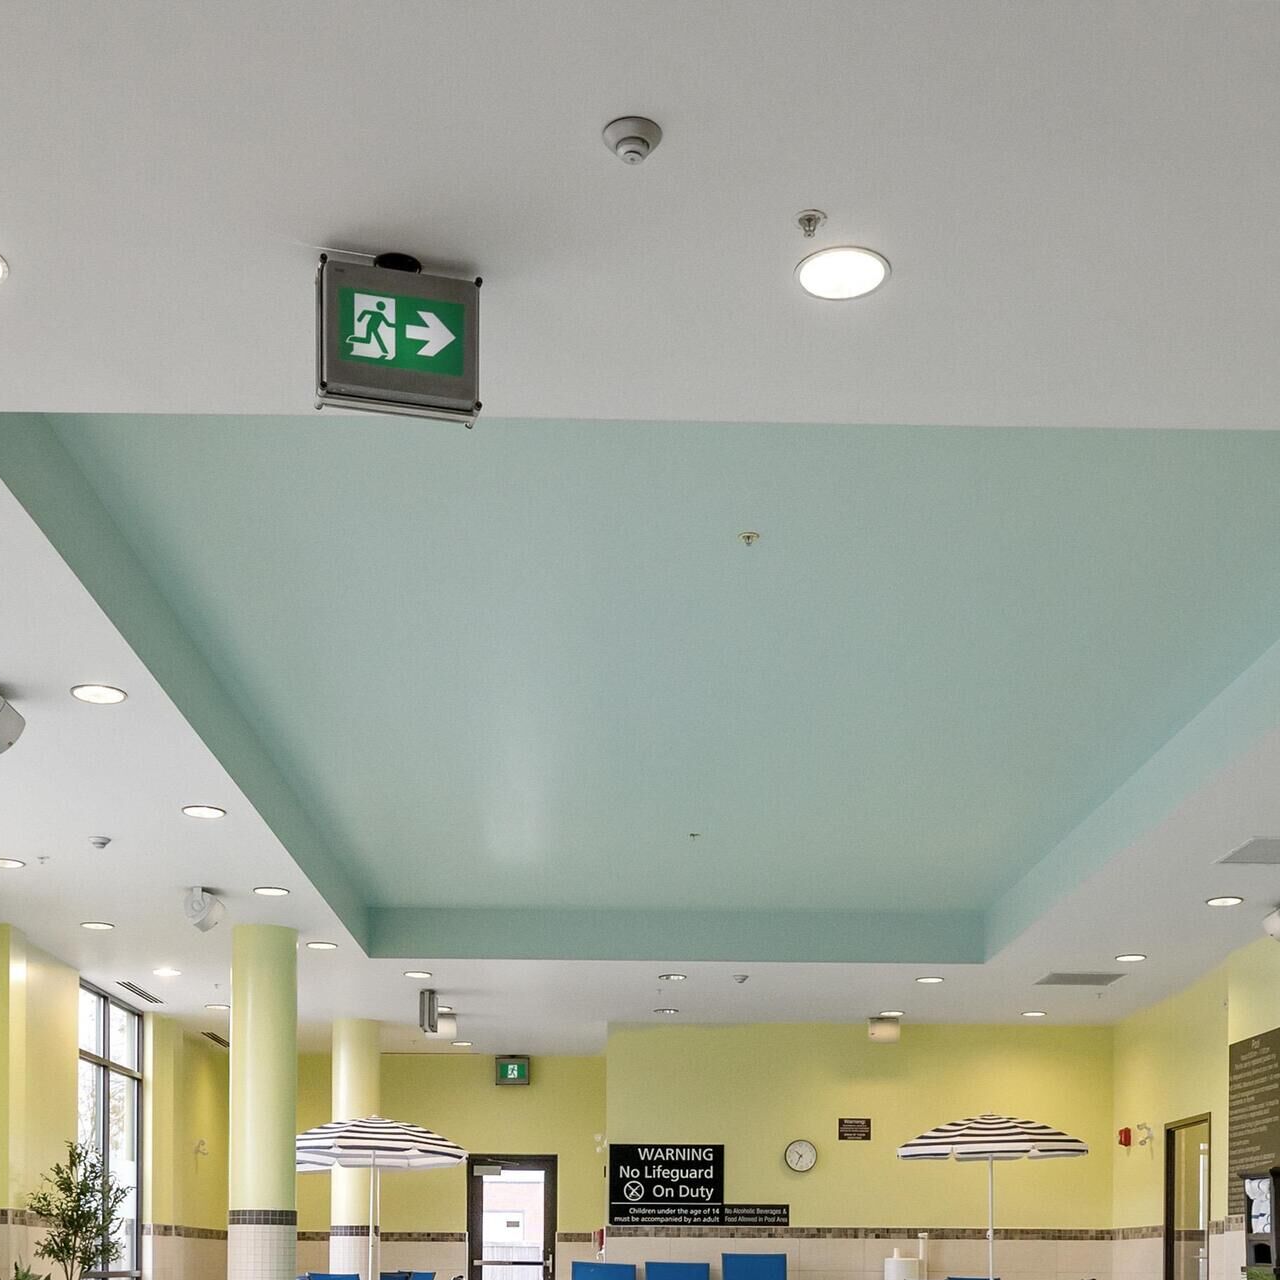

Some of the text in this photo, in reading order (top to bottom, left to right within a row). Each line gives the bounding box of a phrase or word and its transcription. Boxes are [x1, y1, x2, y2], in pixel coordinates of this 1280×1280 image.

[638, 1148, 713, 1161] WARNING
[619, 1165, 714, 1182] No Lifeguard
[652, 1184, 714, 1200] On Duty
